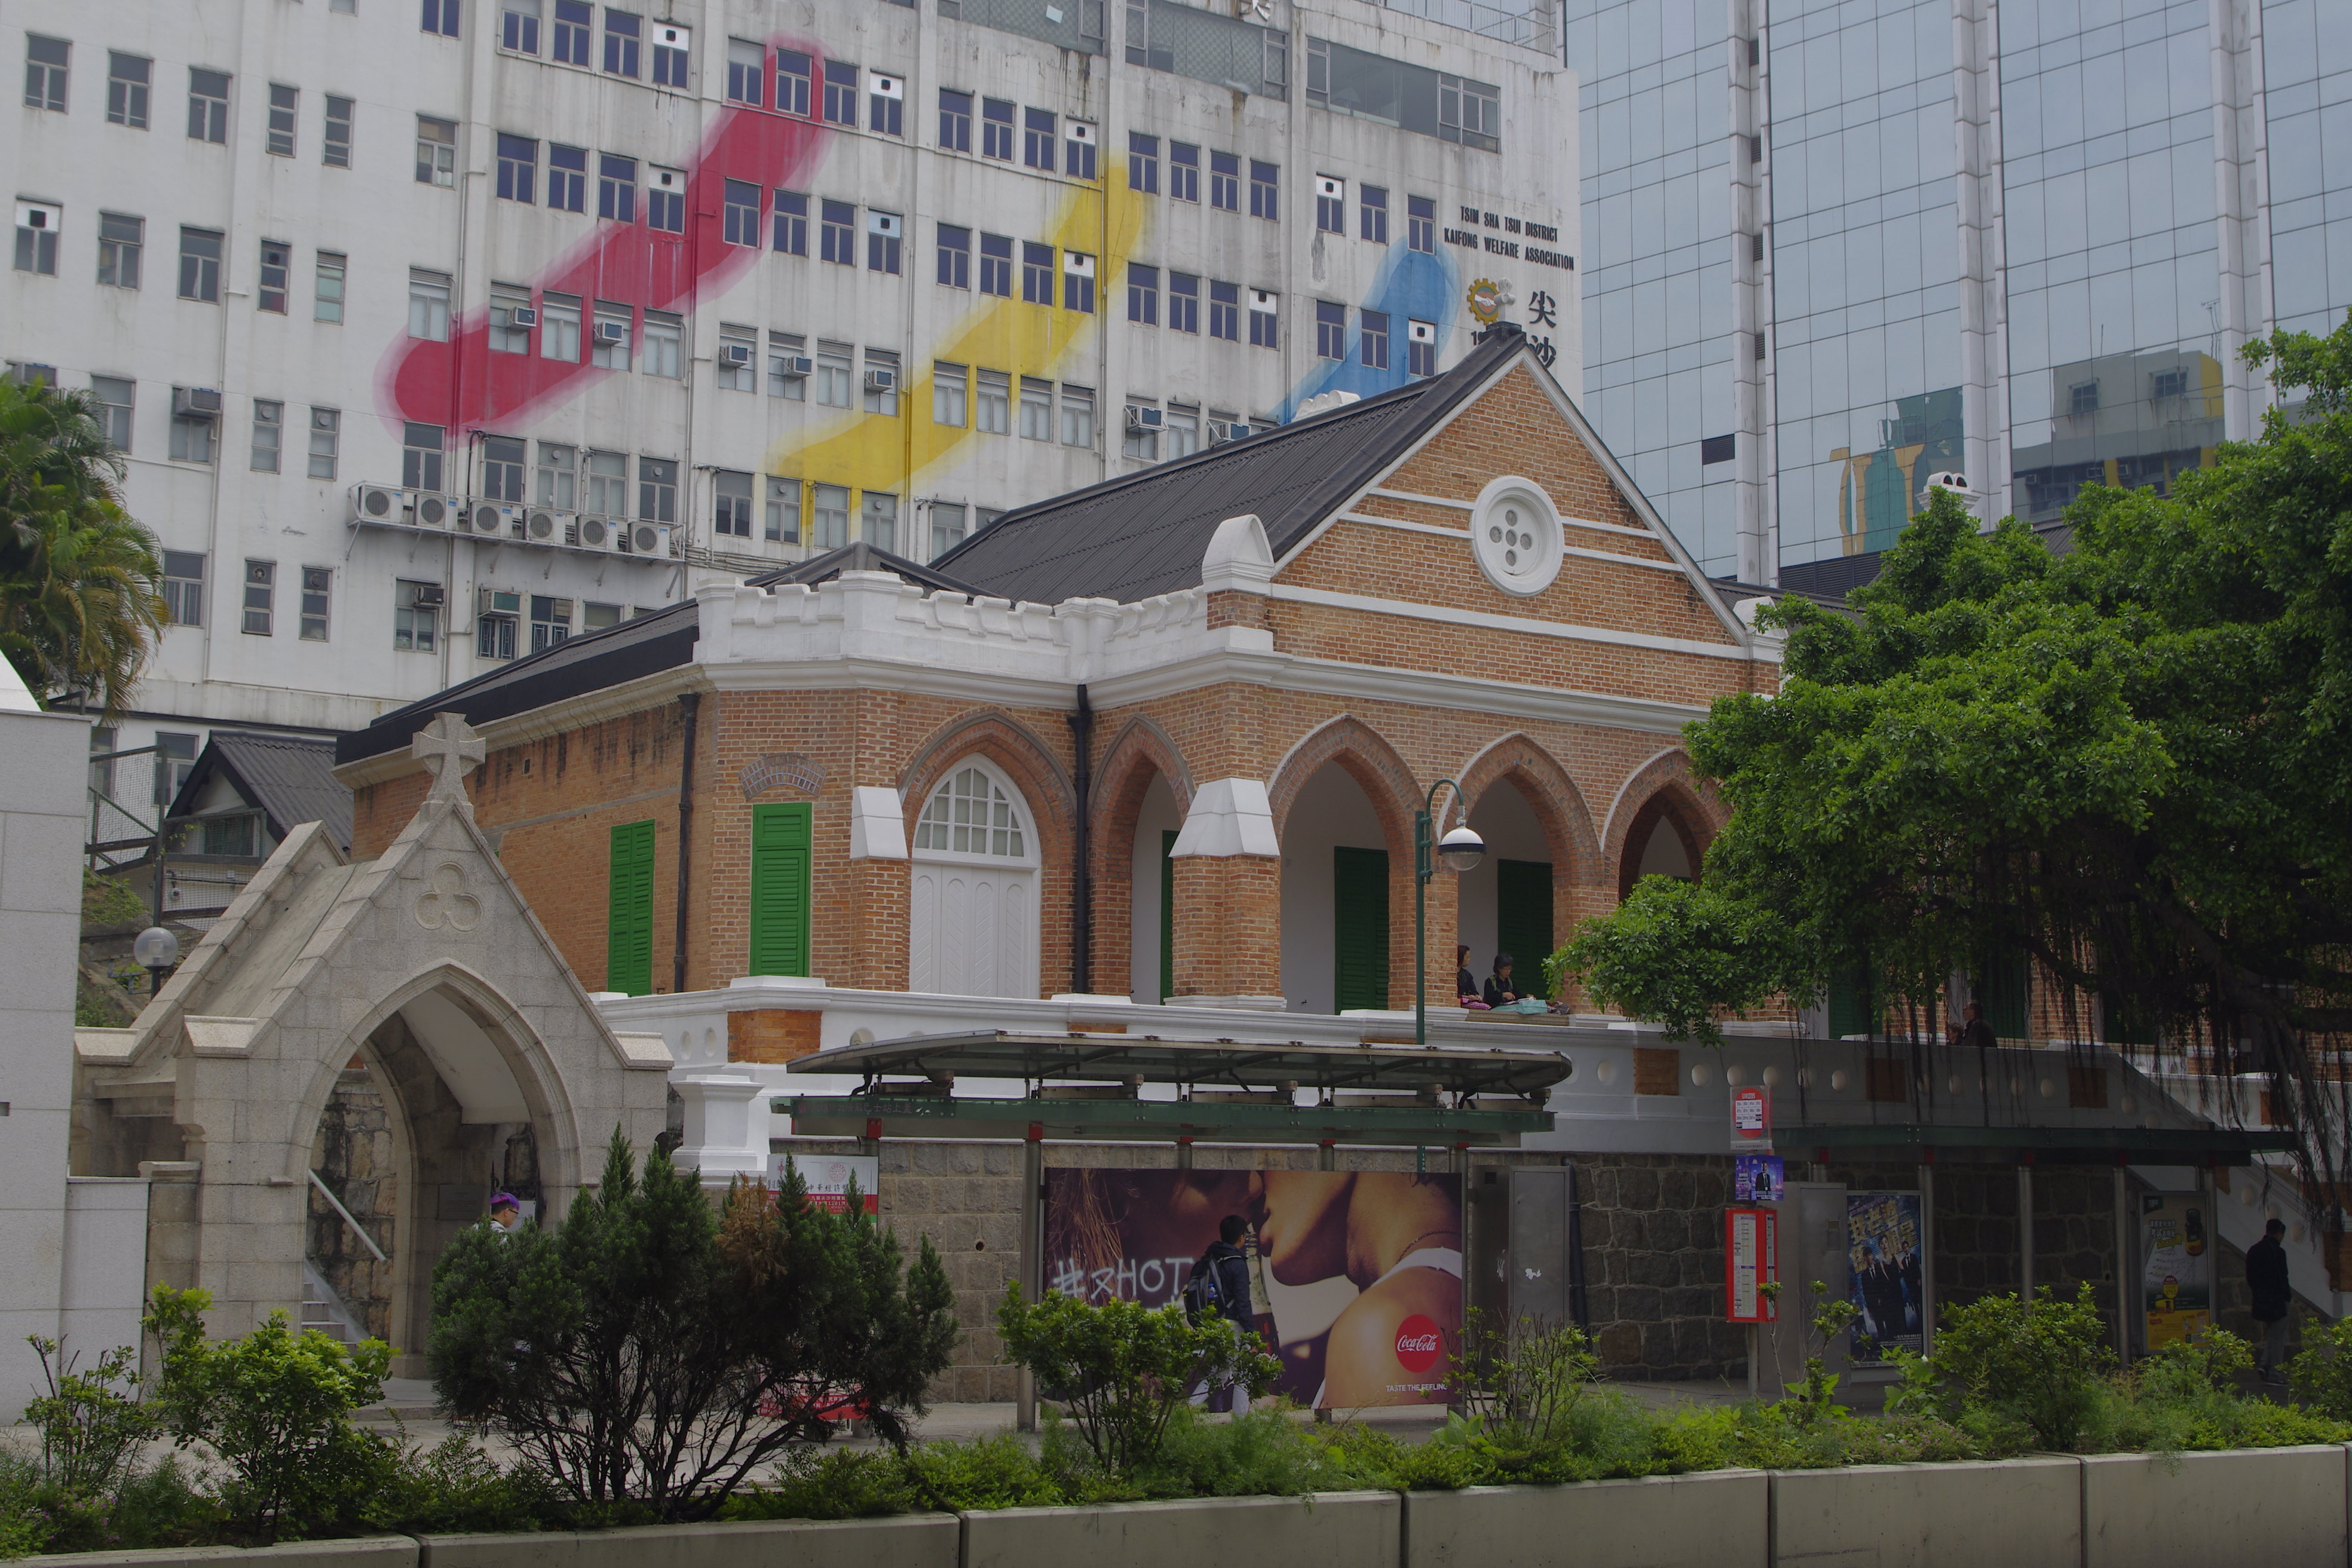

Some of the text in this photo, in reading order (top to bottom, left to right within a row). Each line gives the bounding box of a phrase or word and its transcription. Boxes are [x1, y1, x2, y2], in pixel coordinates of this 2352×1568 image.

[1460, 206, 1558, 243] TSIM SHA TSUI DISTRICT
[1444, 228, 1574, 271] KAIFONG WELFARE ASSOCIATION
[808, 1183, 866, 1193] 中華經筋醫院
[1397, 1334, 1439, 1352] Coca-Cola
